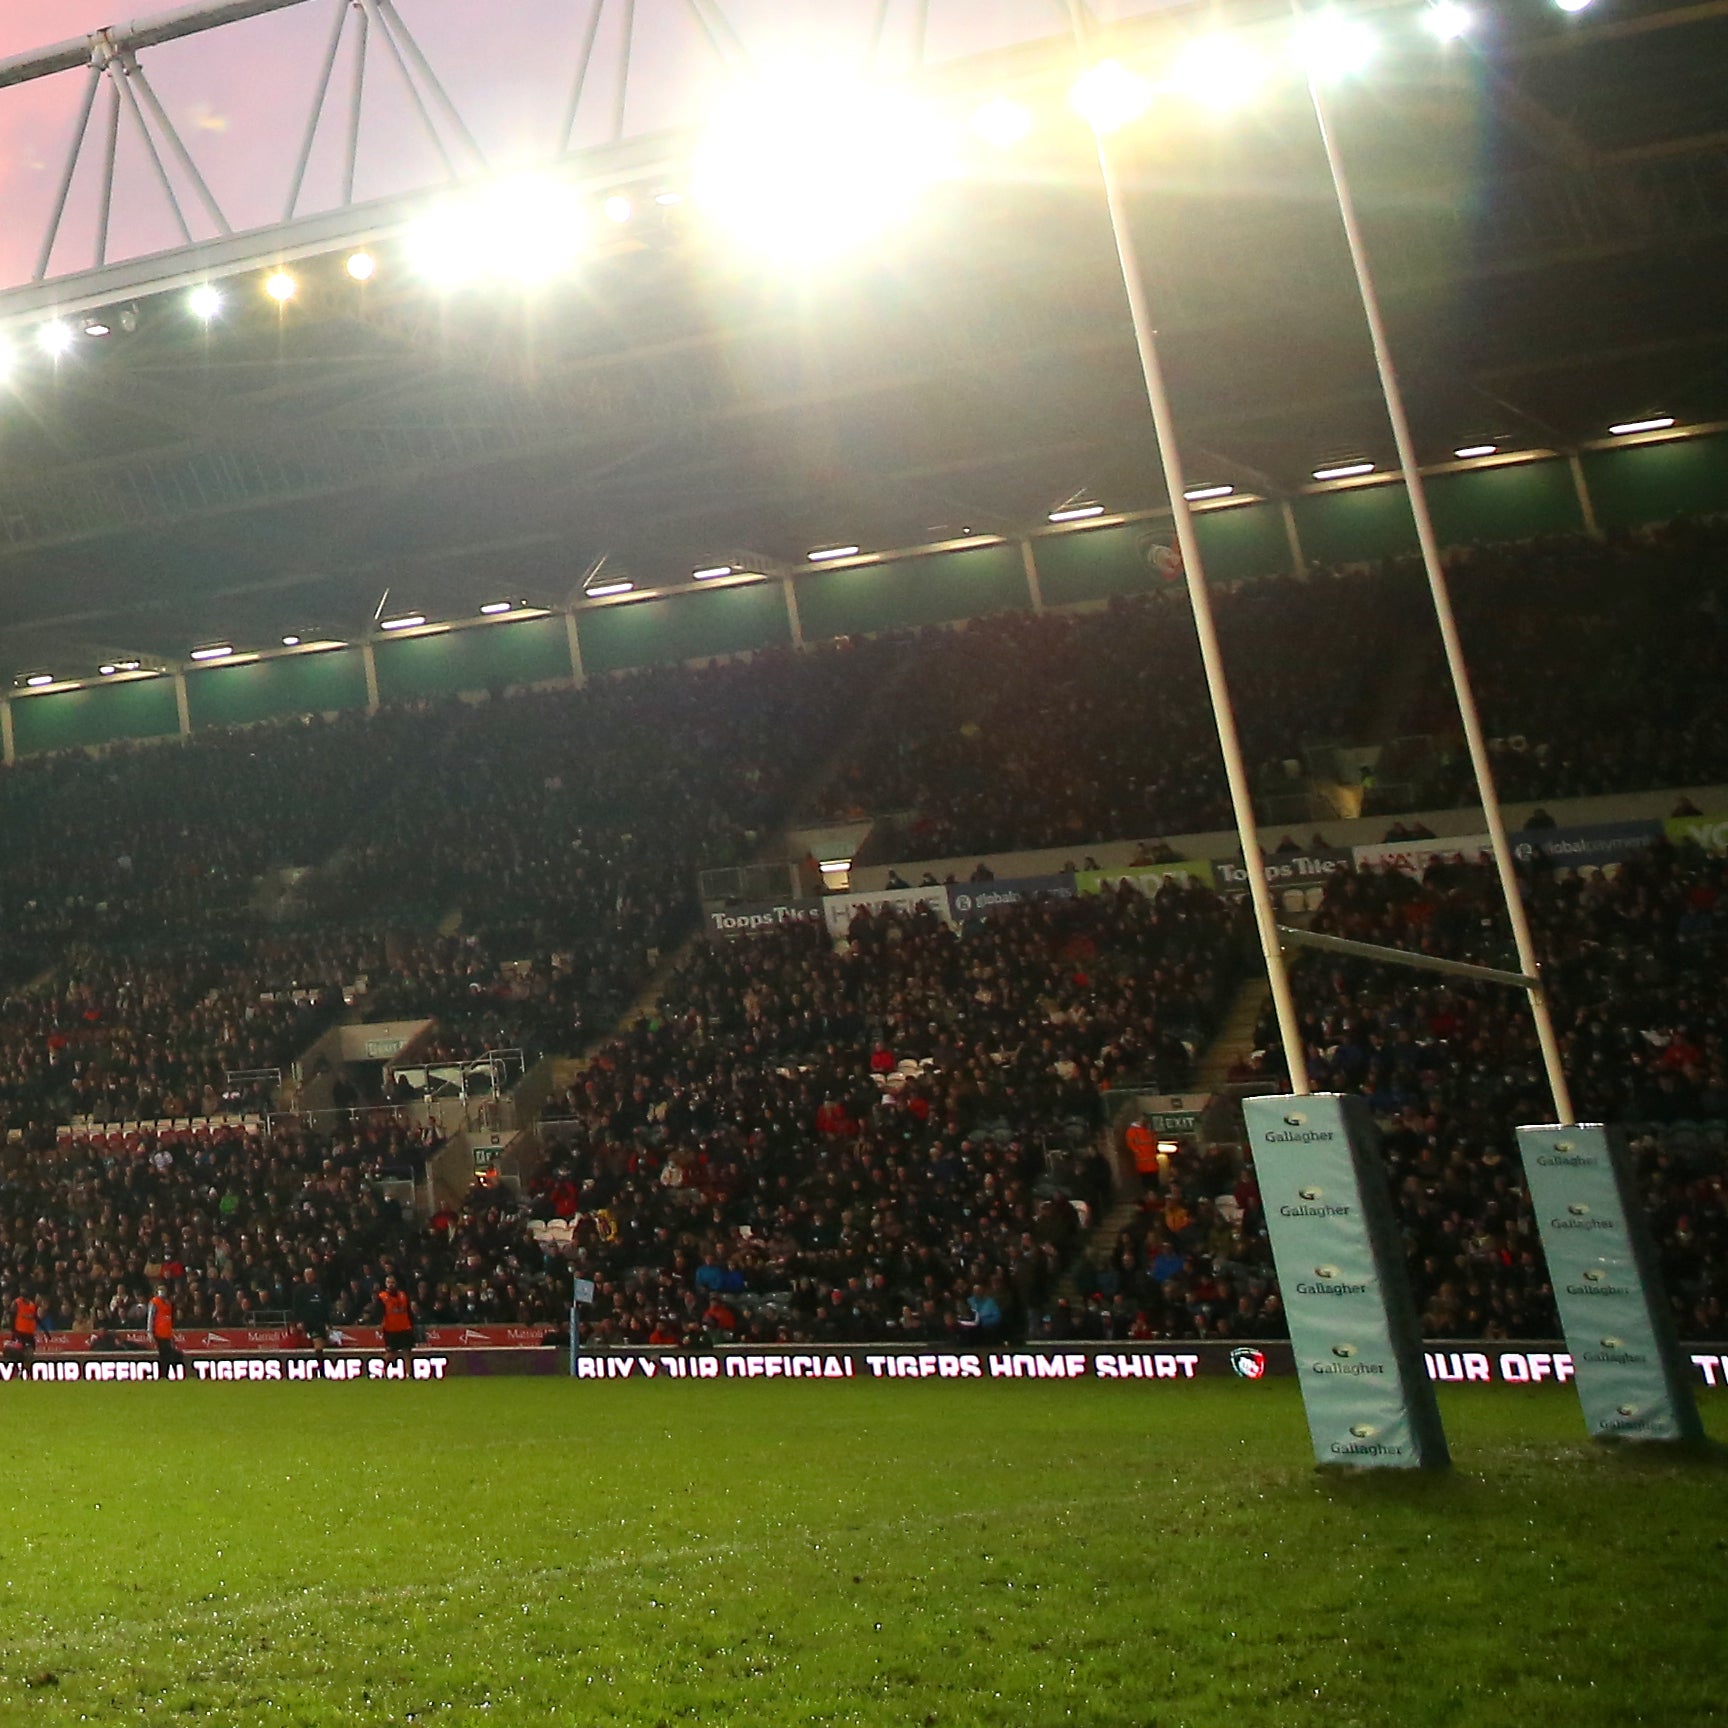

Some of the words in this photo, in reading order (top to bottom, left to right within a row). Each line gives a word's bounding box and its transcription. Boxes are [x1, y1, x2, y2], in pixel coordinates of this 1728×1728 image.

[1217, 863, 1293, 883] Tops
[1165, 1117, 1195, 1130] EXIT
[1264, 1129, 1334, 1145] Gallagher
[1535, 1154, 1599, 1169] Gallagher
[1280, 1203, 1350, 1219] Gallagher
[1551, 1217, 1614, 1231] Gallagher
[1296, 1281, 1367, 1297] Gallagher
[1566, 1283, 1630, 1298] Gallagher
[1582, 1350, 1648, 1366] Gallagher
[193, 1360, 282, 1380] TIGERS
[368, 1357, 447, 1379] SHRT
[578, 1356, 634, 1378] BUY
[725, 1355, 853, 1377] OFFICIAL
[866, 1355, 982, 1377] TIGERS
[989, 1355, 1086, 1377] HOME
[1095, 1355, 1198, 1378] SHIRT
[1312, 1361, 1384, 1377] Gallagher
[1330, 1441, 1403, 1458] Gallagher
